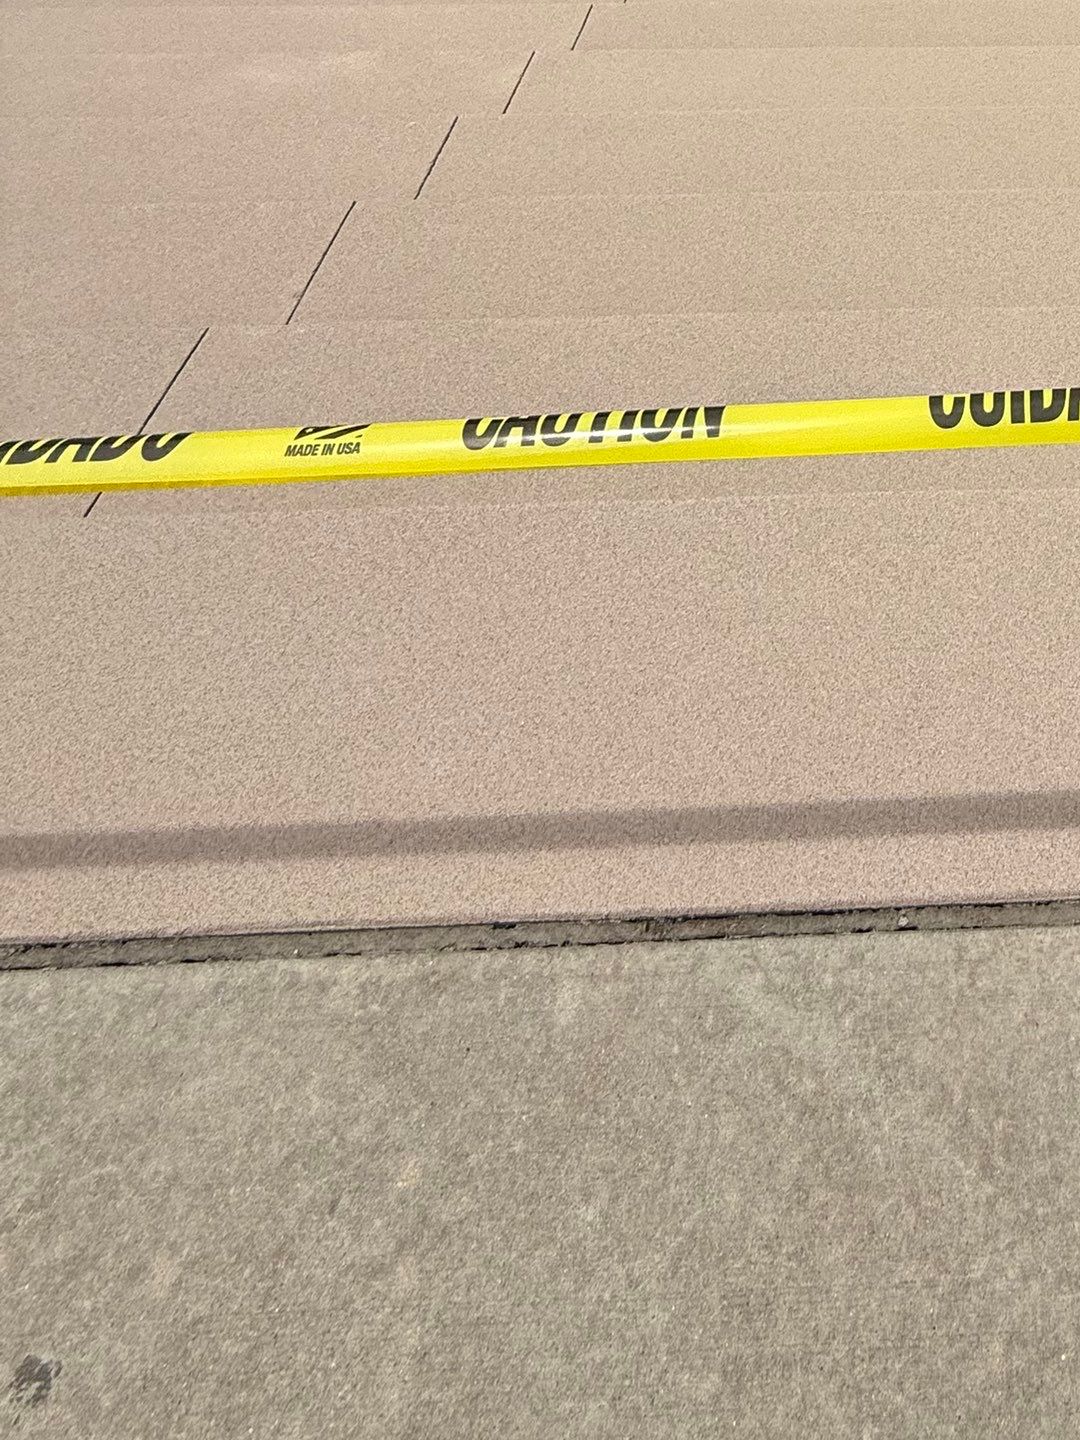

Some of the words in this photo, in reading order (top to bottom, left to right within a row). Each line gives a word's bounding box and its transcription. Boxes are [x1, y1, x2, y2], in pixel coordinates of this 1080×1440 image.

[284, 444, 321, 457] MADE
[321, 443, 336, 456] IN
[336, 442, 361, 455] USA
